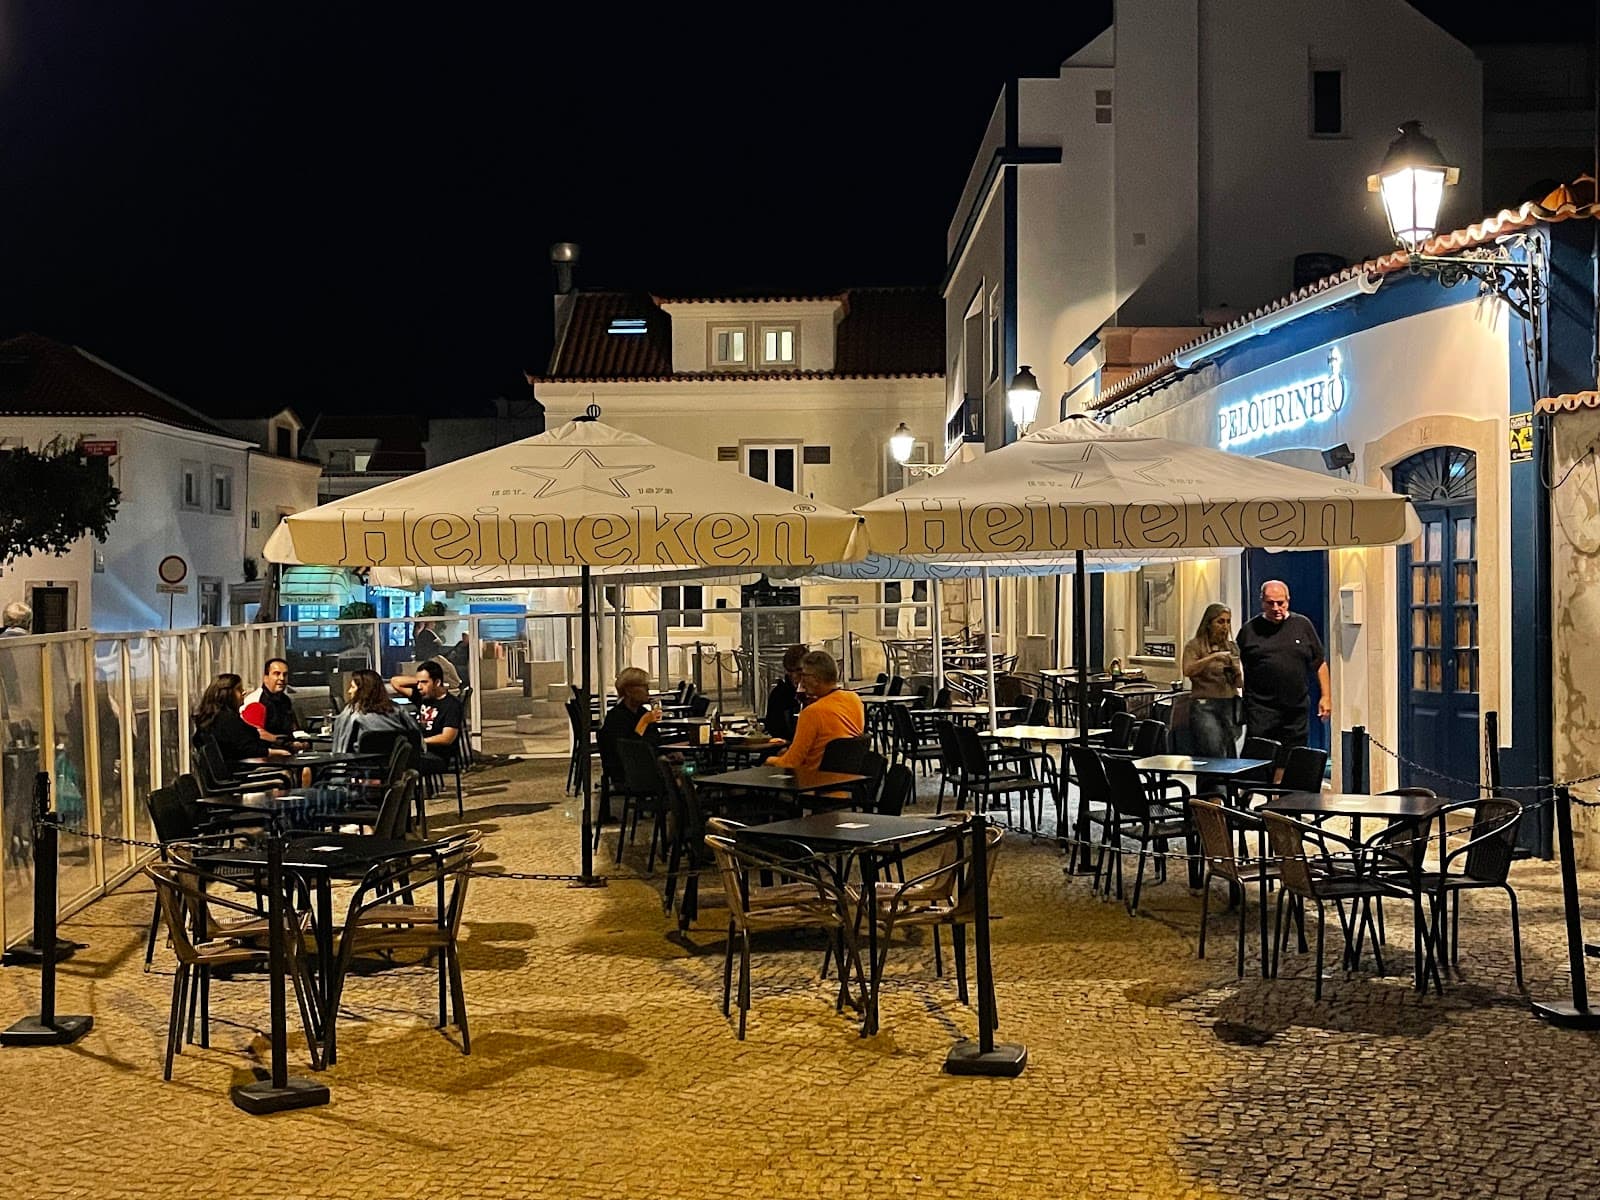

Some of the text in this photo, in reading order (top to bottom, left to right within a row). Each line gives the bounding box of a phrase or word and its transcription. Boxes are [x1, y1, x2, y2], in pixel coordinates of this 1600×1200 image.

[1217, 377, 1345, 442] PELOURINHO
[337, 505, 815, 567] Heineken
[895, 493, 1361, 553] Heineken
